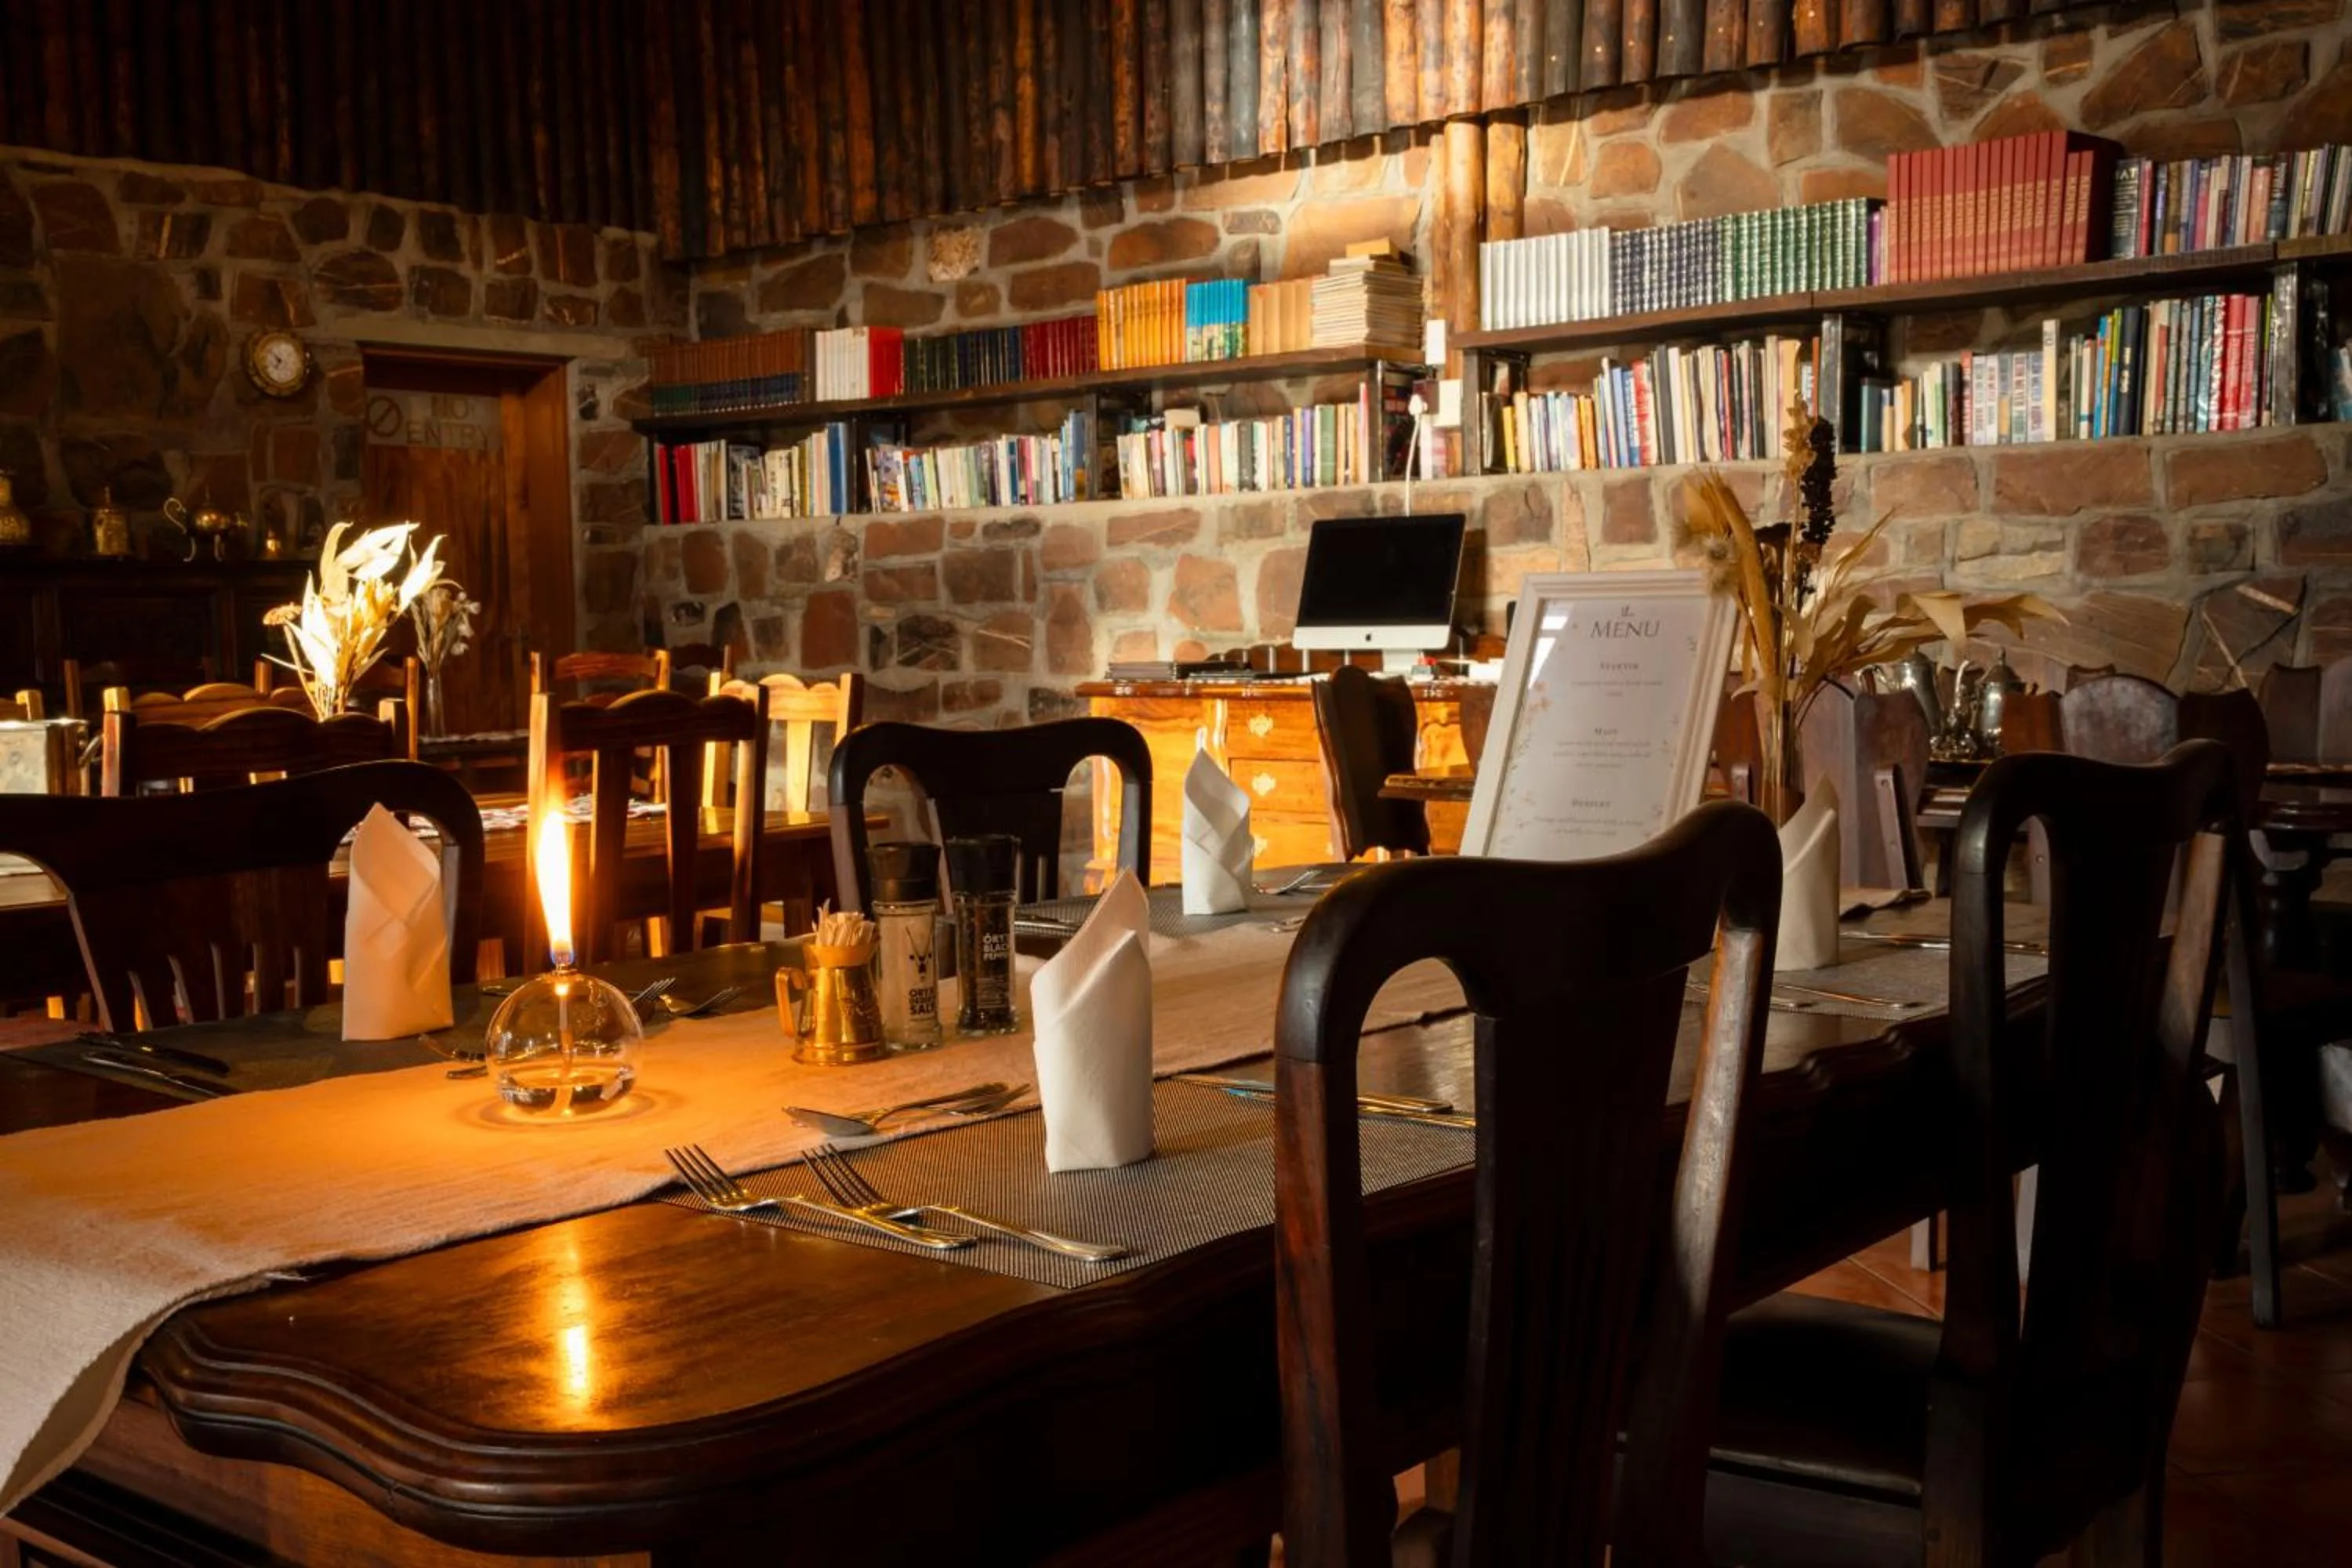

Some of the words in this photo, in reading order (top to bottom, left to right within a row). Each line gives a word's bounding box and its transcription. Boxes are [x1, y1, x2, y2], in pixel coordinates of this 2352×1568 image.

[431, 393, 469, 419] NO
[407, 418, 488, 449] ENTRY
[1590, 619, 1661, 638] MENU
